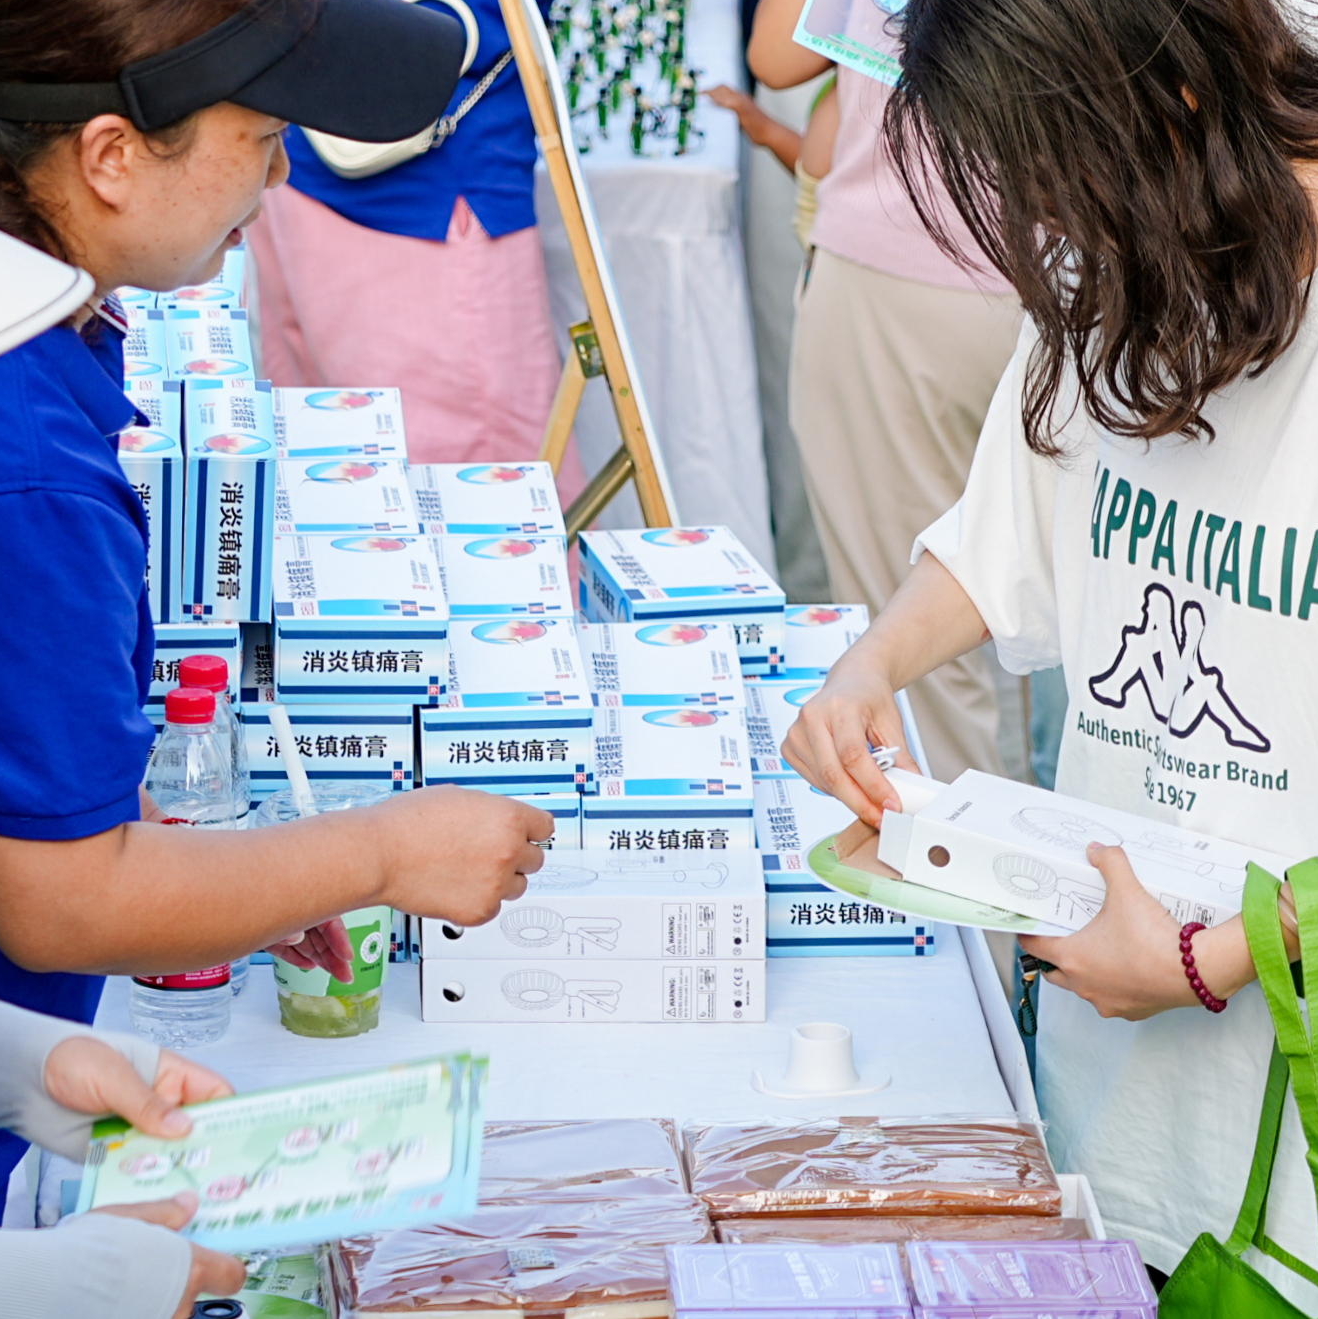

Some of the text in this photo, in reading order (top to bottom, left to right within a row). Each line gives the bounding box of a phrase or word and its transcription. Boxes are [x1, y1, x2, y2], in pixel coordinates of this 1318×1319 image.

[1090, 460, 1178, 577] APPA
[216, 482, 244, 600] 消炎镇痛膏
[285, 560, 317, 599] 消炎镇痛膏
[303, 650, 423, 673] 消炎镇痛膏
[592, 652, 620, 692] 消炎镇痛膏
[449, 739, 569, 764] 消炎镇痛膏
[595, 736, 624, 777] 消炎镇痛膏
[1077, 711, 1154, 751] Authentic
[1226, 760, 1289, 792] Brand
[1156, 781, 1197, 814] 1967
[609, 829, 729, 850] 消炎镇痛膏
[767, 807, 801, 851] 消炎镇痛膏
